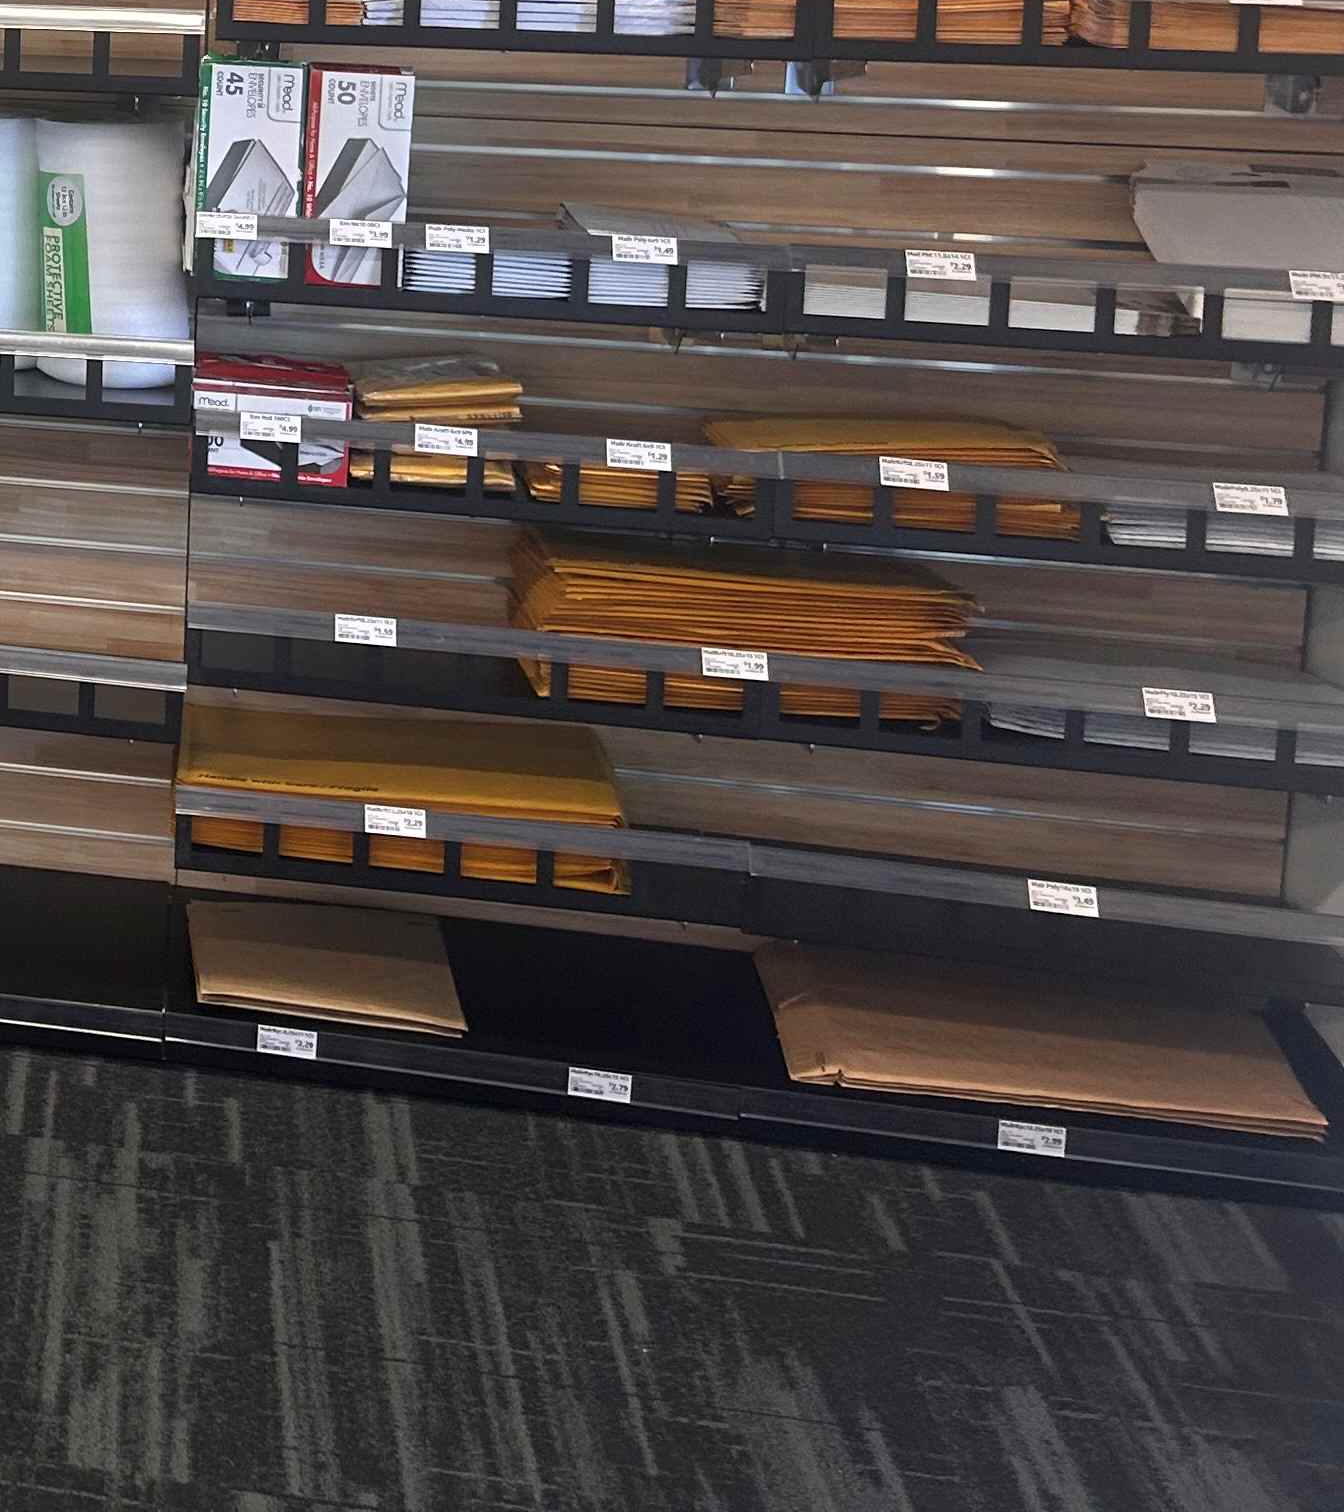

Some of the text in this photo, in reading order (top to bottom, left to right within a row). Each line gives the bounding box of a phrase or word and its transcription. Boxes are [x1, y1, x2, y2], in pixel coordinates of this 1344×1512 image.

[215, 71, 223, 96] COUNT
[226, 72, 244, 96] 45
[246, 72, 256, 119] ENVELOPES
[327, 78, 336, 105] COUNT
[338, 80, 356, 105] 50
[358, 81, 369, 127] ENVELOPES
[53, 236, 63, 320] PROTECTIVE
